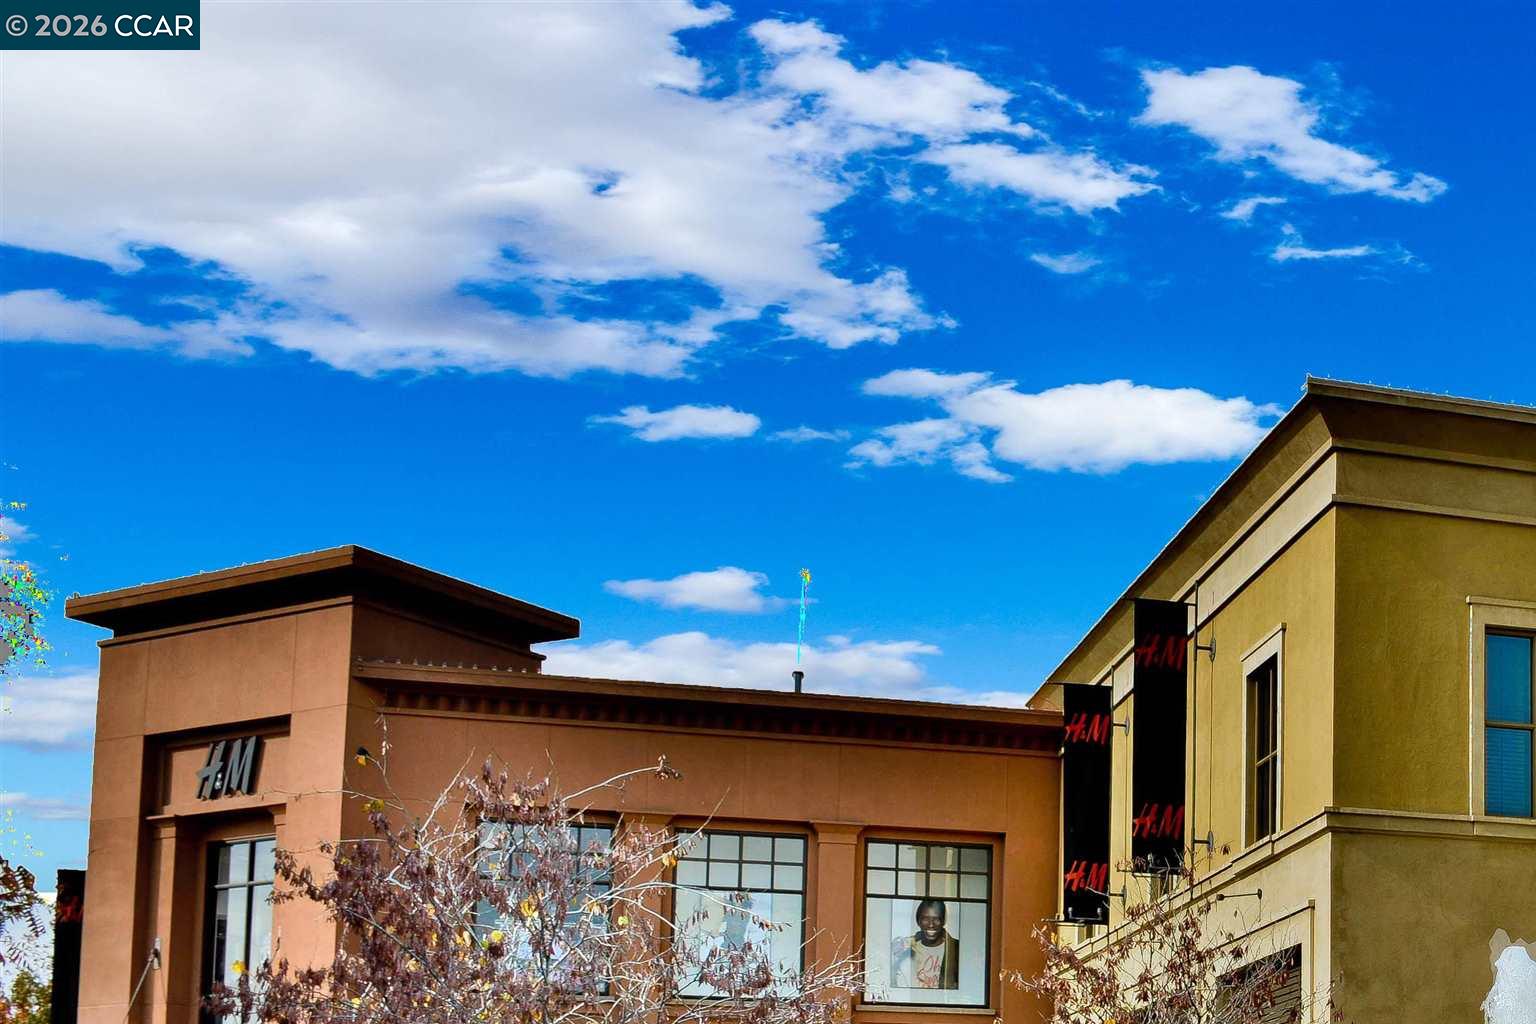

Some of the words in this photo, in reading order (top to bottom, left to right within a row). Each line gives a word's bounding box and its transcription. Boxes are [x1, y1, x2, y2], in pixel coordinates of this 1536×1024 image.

[1064, 711, 1112, 745] H&M
[195, 735, 262, 800] H&M
[1132, 802, 1186, 841] H&M
[1064, 859, 1109, 892] H&M
